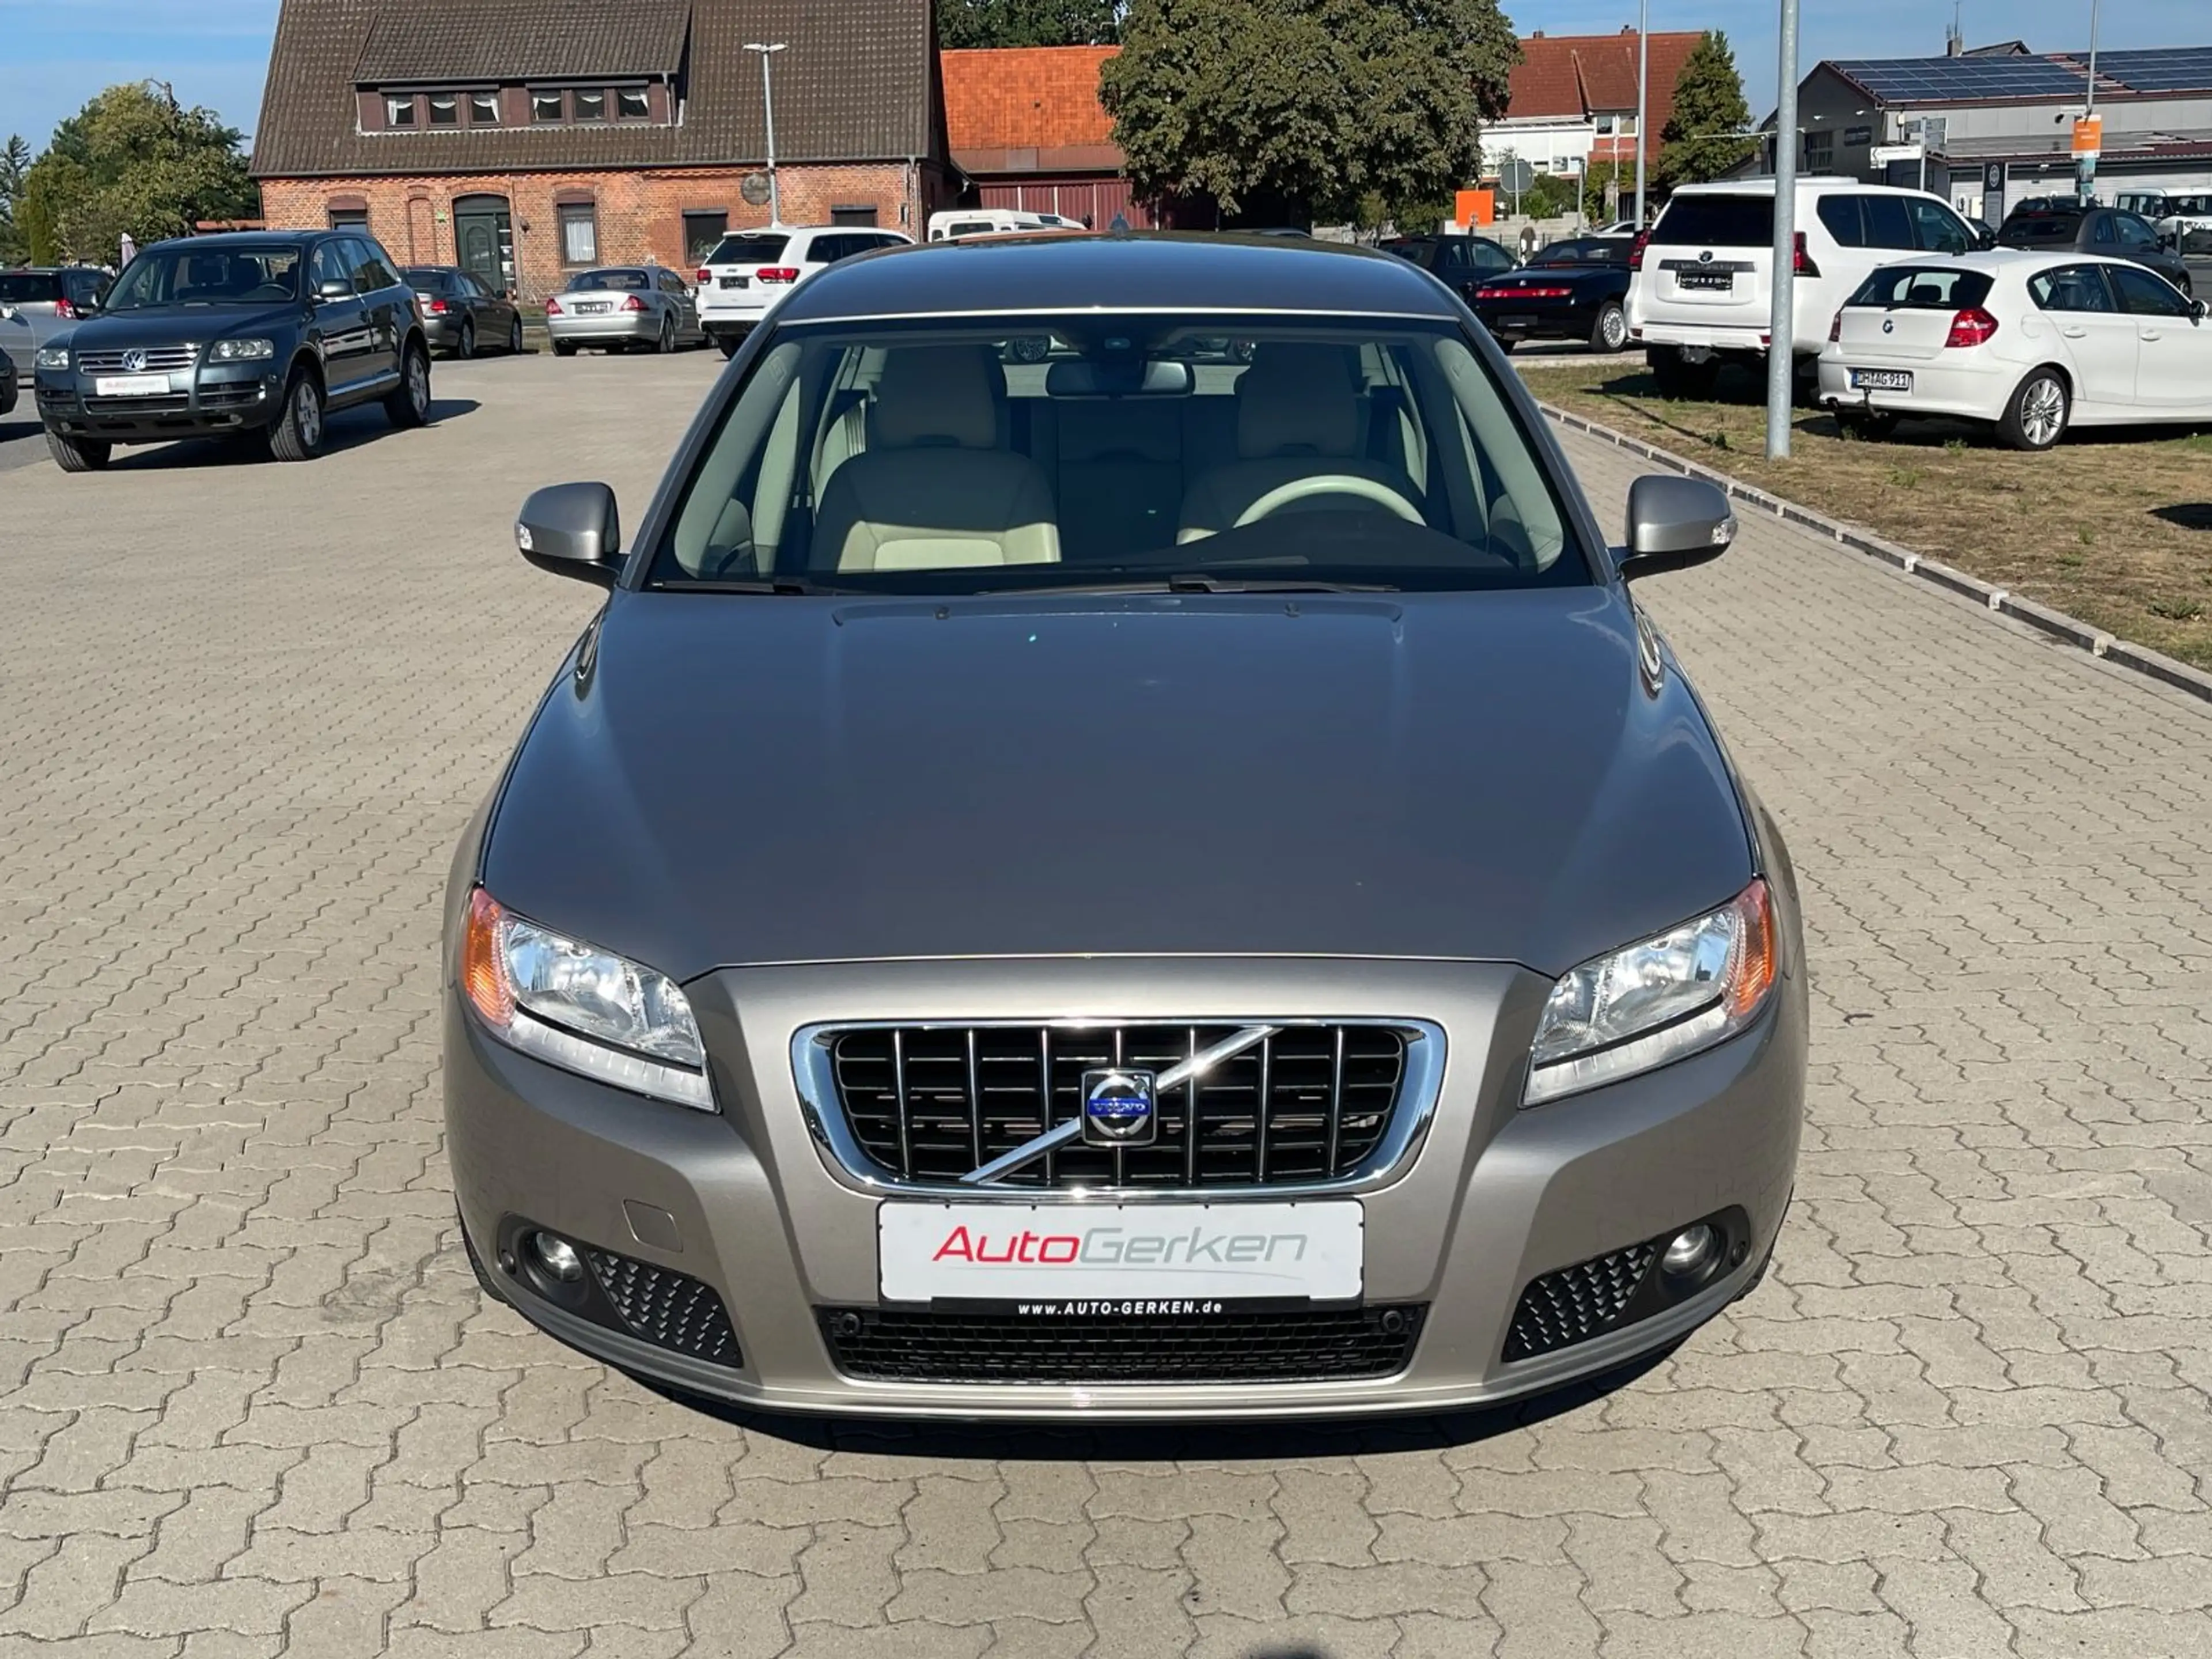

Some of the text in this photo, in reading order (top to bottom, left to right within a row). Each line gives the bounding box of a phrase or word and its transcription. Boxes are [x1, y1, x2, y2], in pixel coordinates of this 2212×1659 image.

[1874, 373, 1887, 385] AG
[1889, 373, 1907, 386] 911
[1018, 1301, 1222, 1315] www.AUTO-GERKEN.de
